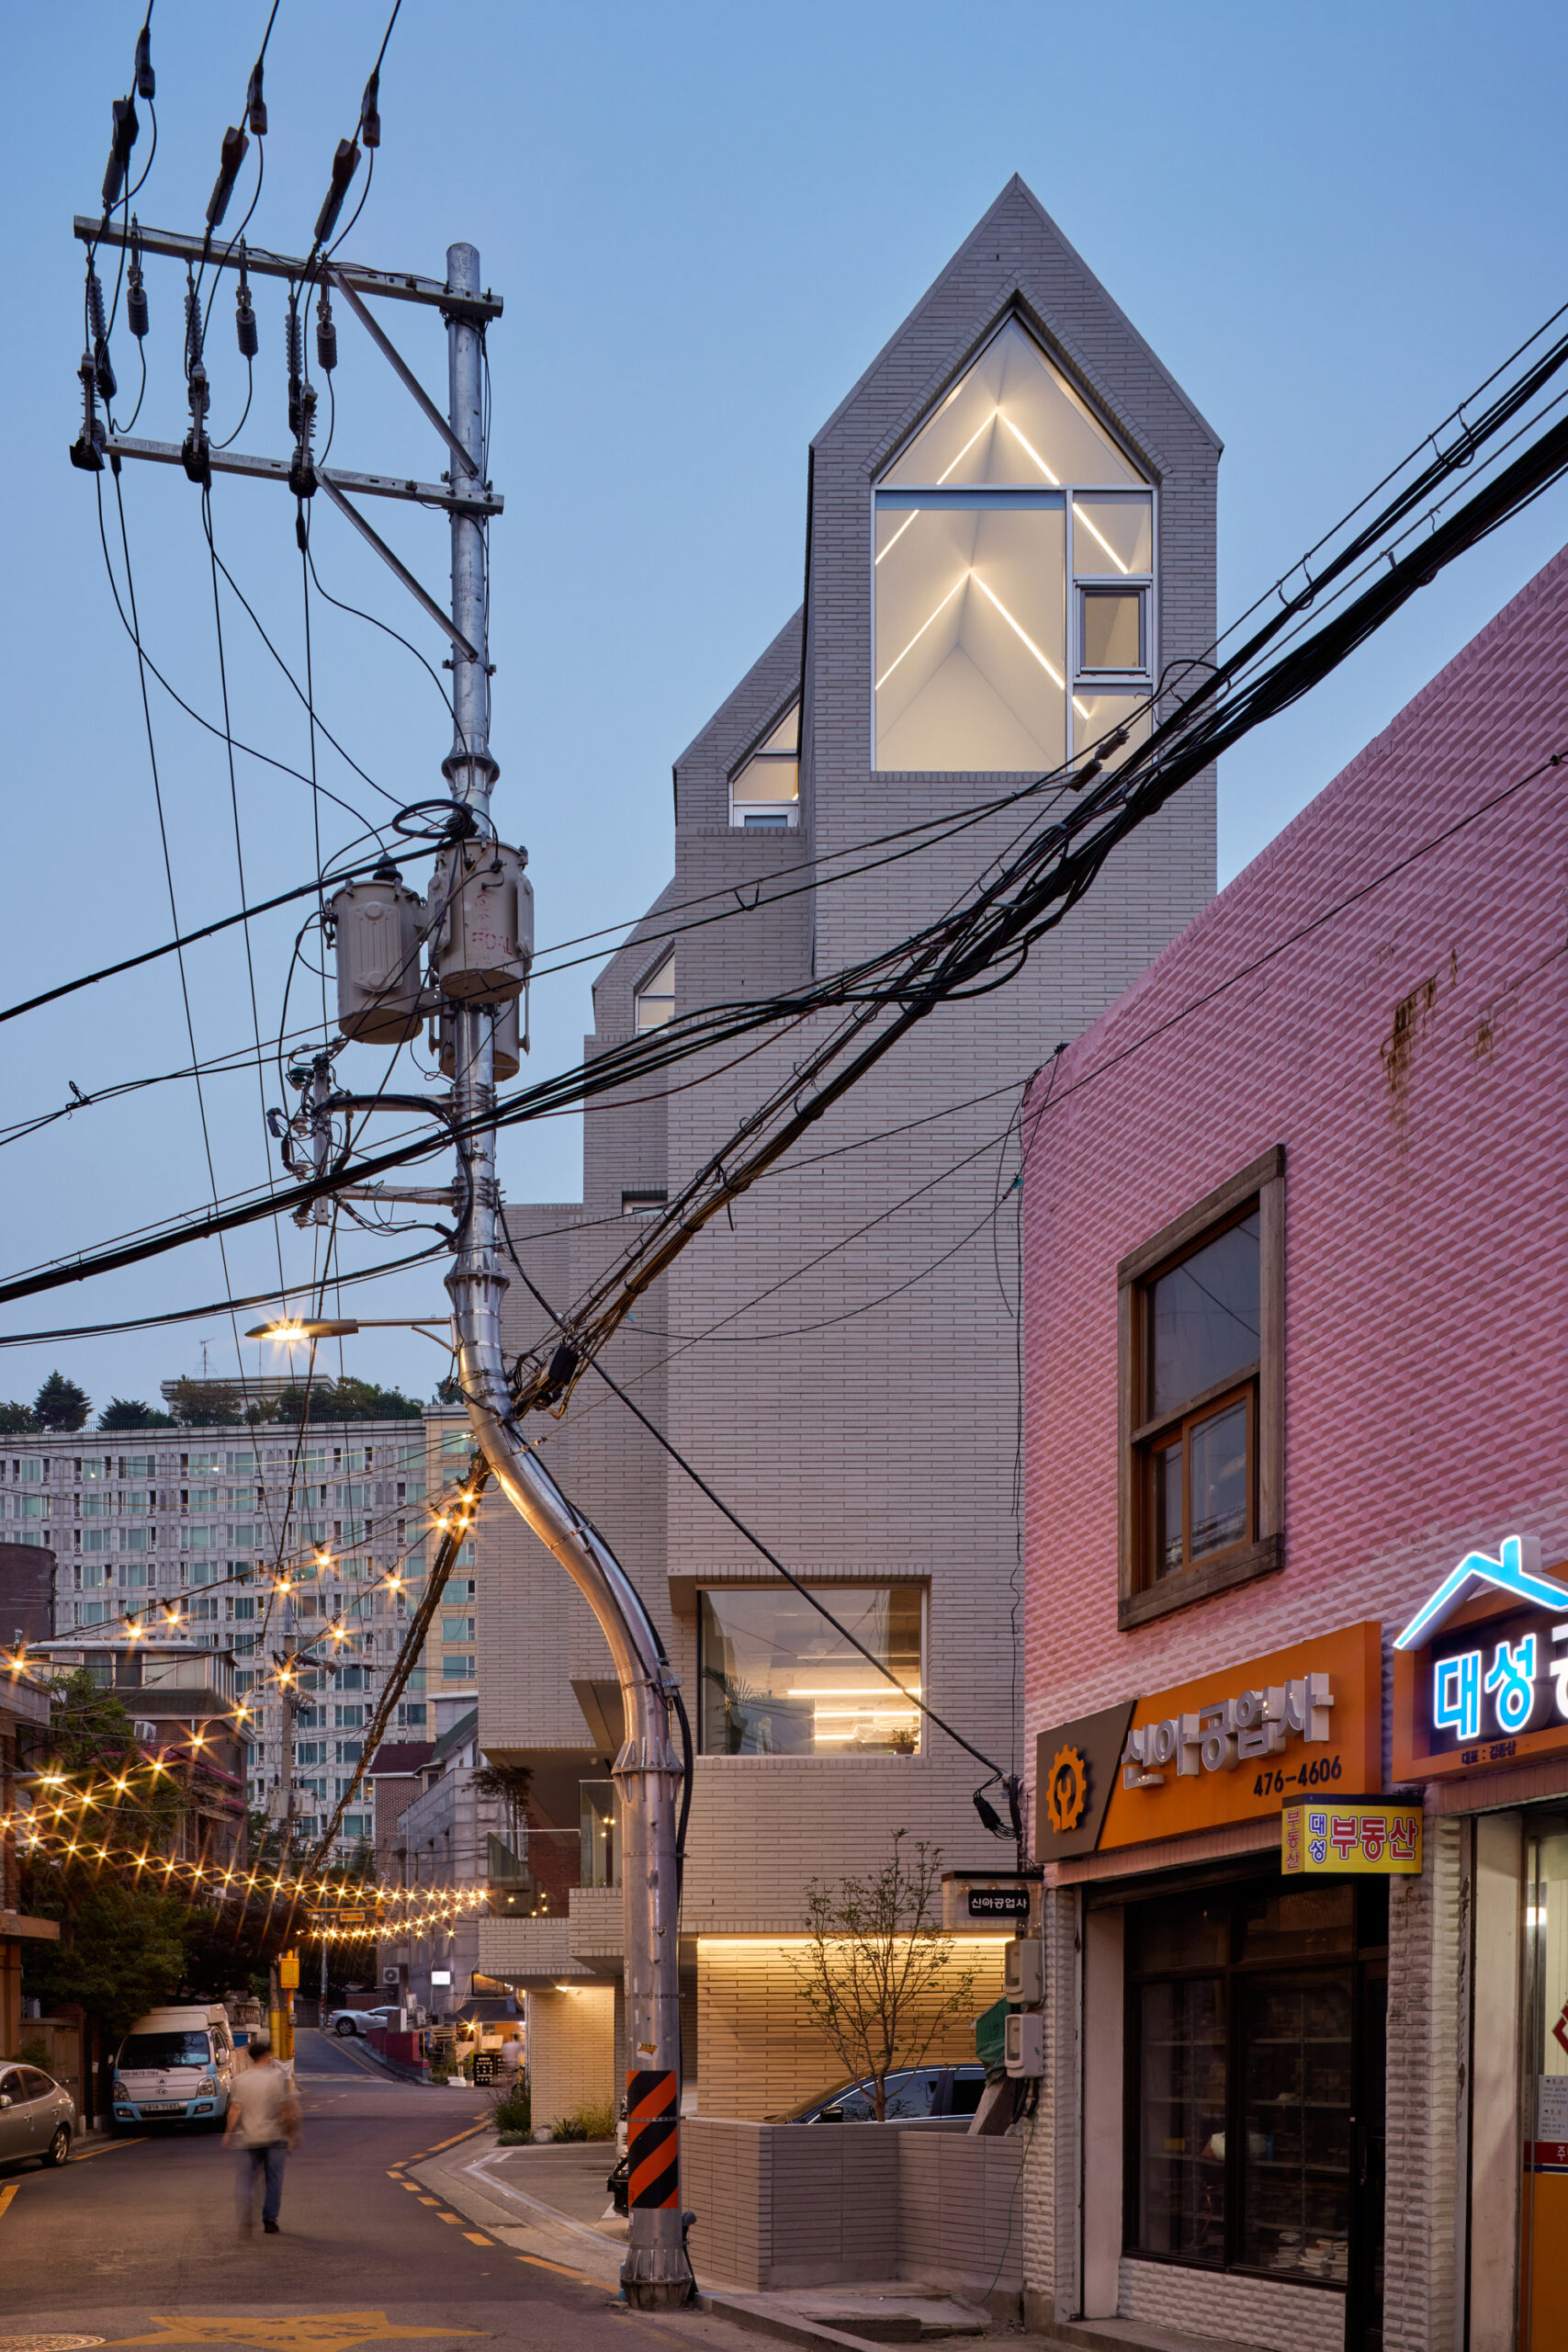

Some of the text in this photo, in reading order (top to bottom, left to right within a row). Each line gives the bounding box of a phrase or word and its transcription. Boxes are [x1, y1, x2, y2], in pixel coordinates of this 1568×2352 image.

[1122, 1673, 1334, 1790] 신아공업사
[1253, 1756, 1342, 1797] 476-4606
[1287, 1809, 1301, 1871] 부동산
[1309, 1813, 1418, 1863] 대성 부동산
[971, 1897, 1027, 1909] 신아공업사
